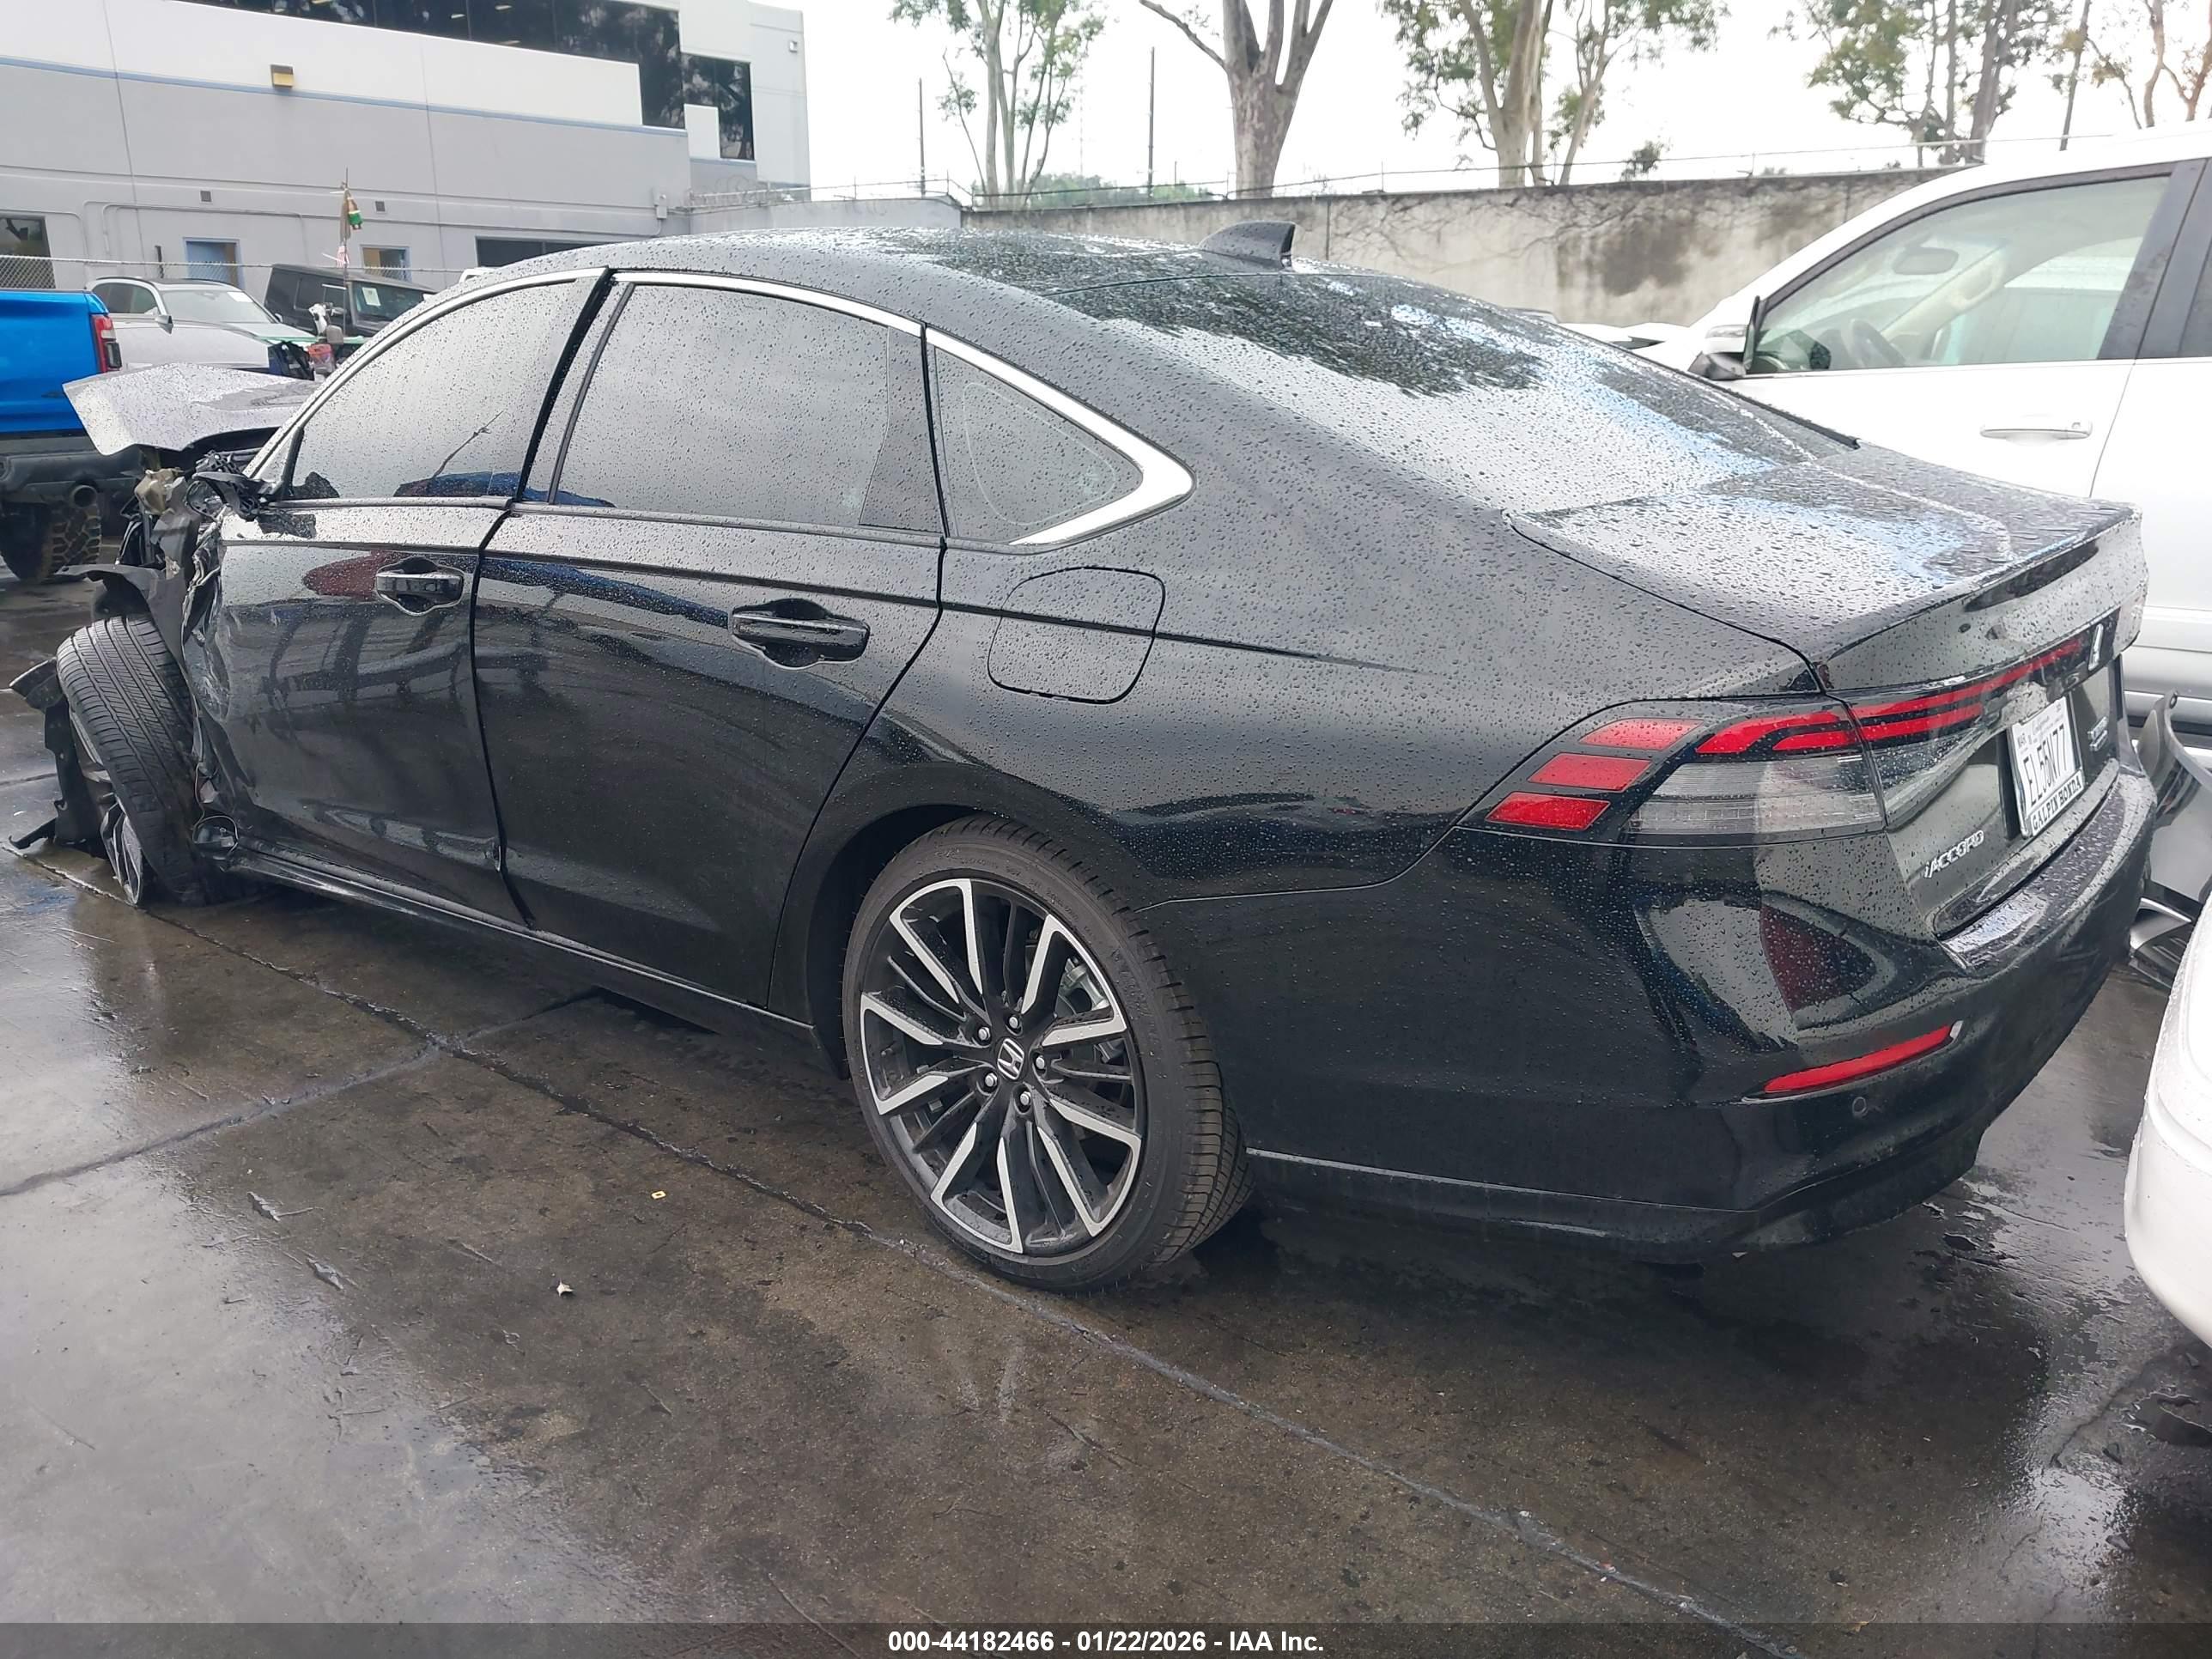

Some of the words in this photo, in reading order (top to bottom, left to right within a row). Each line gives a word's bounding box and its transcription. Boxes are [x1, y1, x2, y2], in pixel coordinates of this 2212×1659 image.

[2032, 793, 2058, 830] GALPIN
[2058, 778, 2082, 808] HONDA
[1926, 830, 1984, 878] ACCORD
